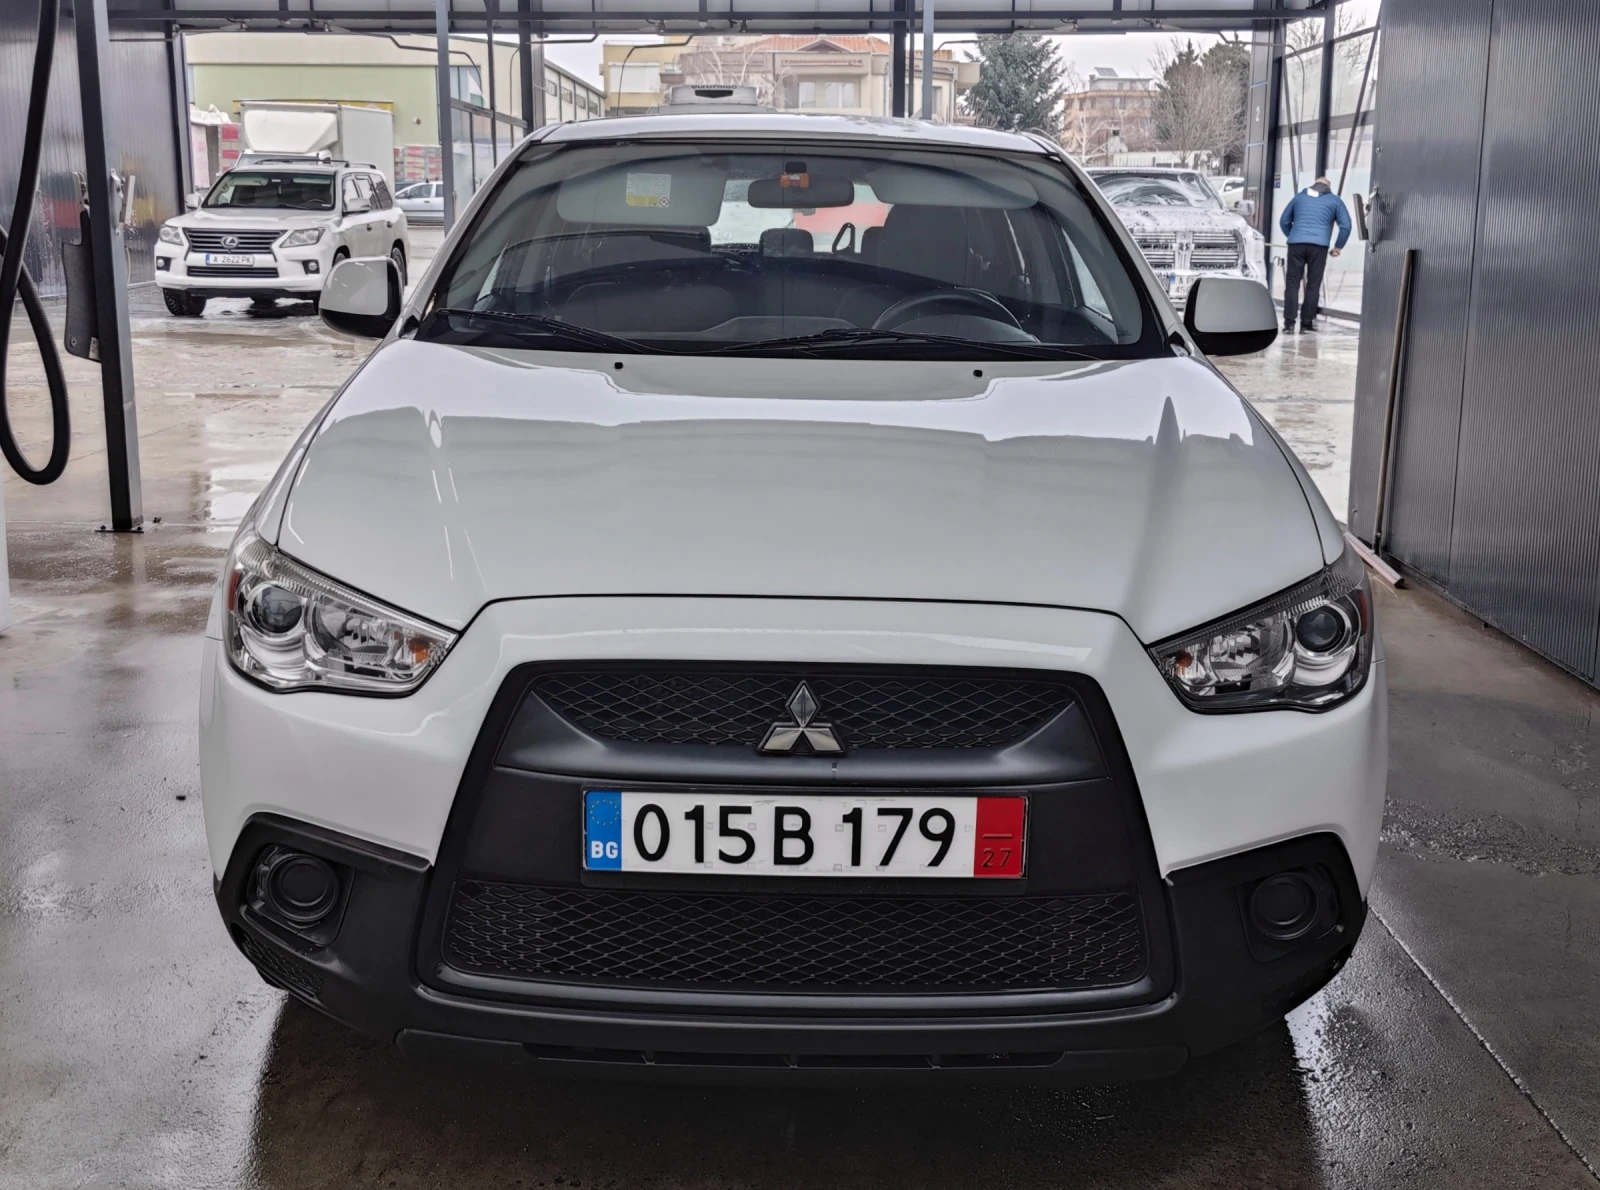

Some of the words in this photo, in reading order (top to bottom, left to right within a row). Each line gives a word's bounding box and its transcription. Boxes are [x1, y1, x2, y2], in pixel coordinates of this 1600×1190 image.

[1255, 105, 1260, 122] 2
[591, 840, 618, 859] BG
[981, 847, 1012, 868] 27
